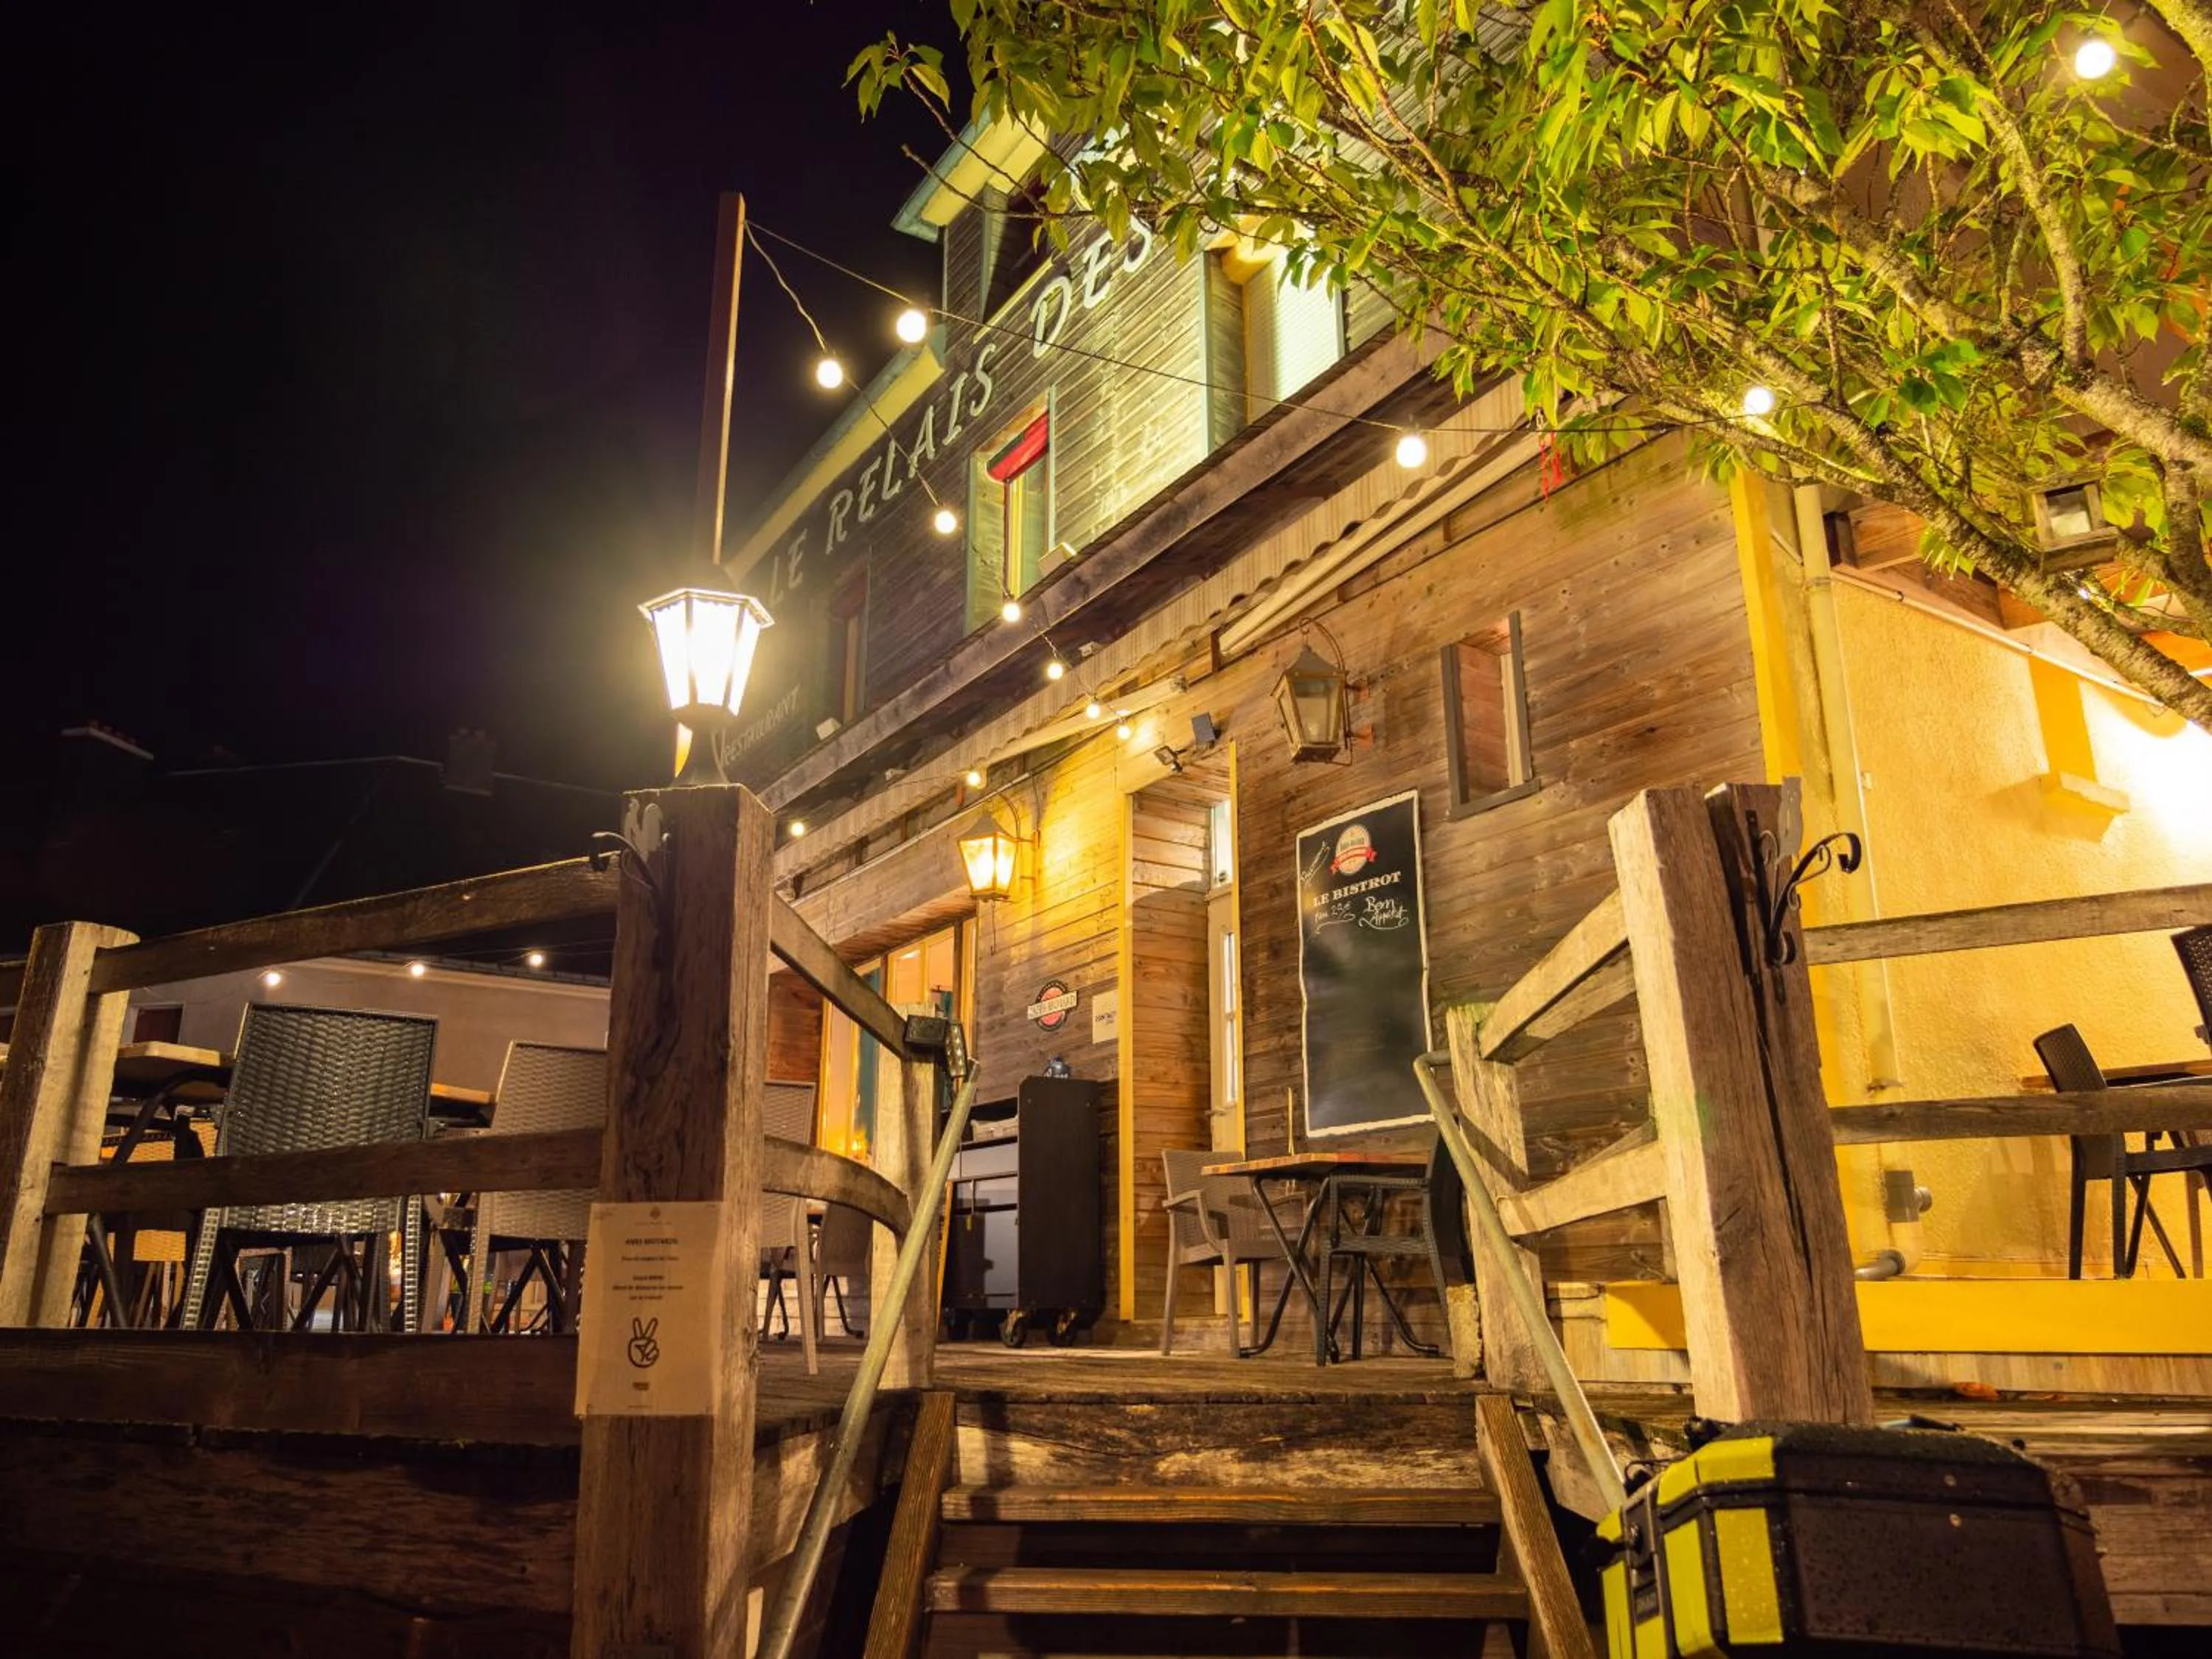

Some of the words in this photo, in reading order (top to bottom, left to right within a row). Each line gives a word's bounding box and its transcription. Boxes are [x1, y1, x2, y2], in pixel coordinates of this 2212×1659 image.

[769, 528, 808, 606] LE
[824, 343, 996, 555] RELAIS
[1030, 215, 1152, 358] DES
[1314, 893, 1329, 907] LE
[1332, 871, 1402, 900] BISTROT
